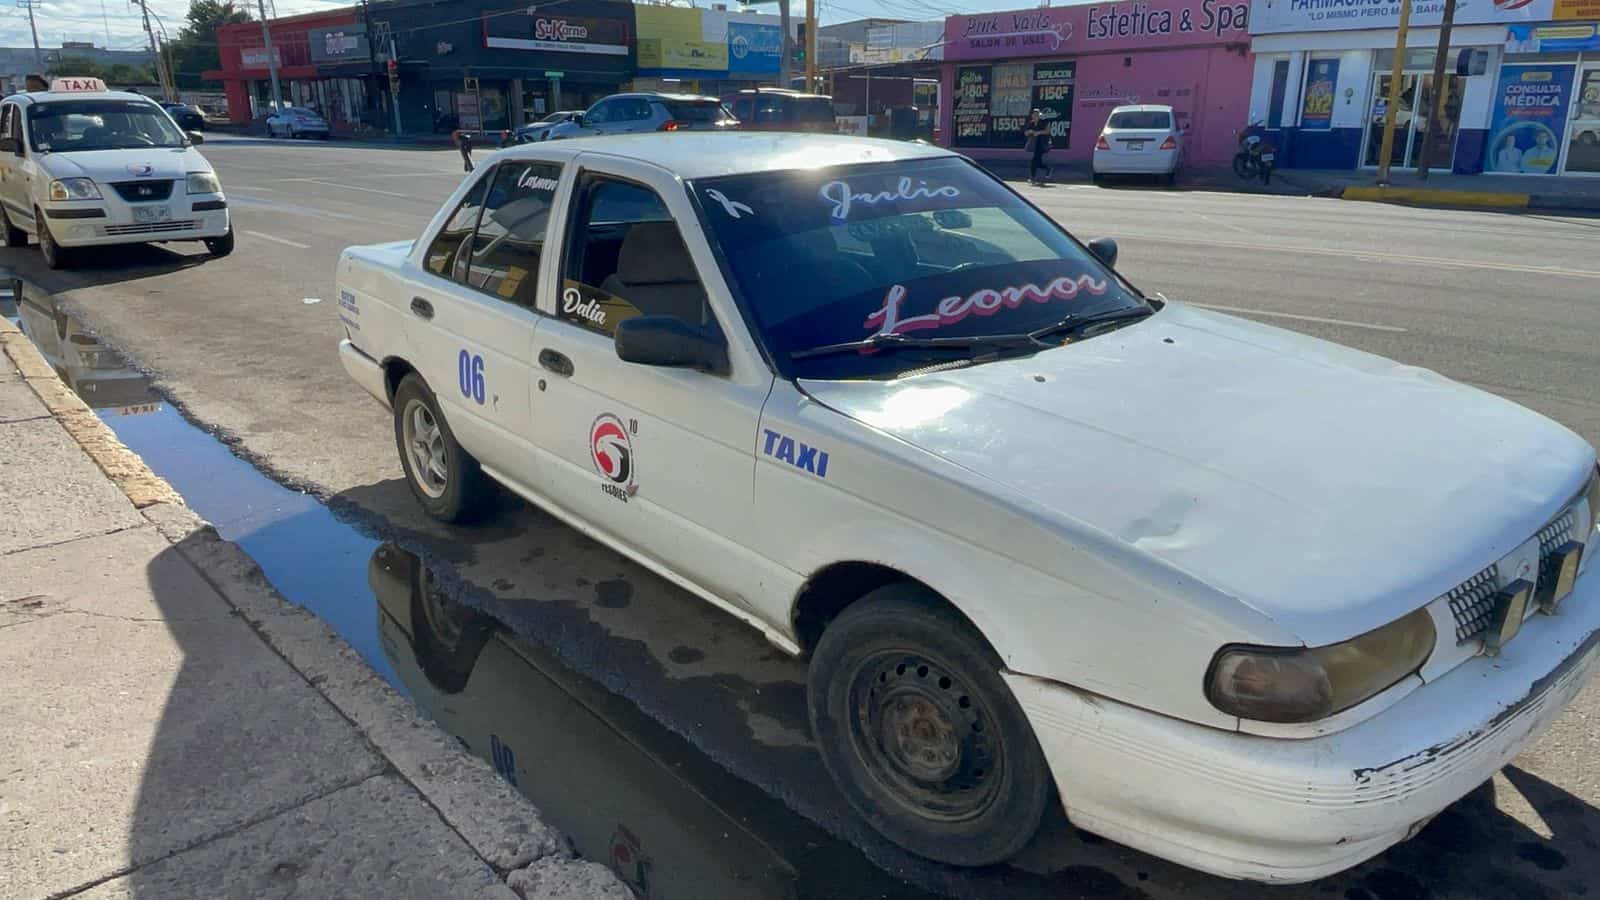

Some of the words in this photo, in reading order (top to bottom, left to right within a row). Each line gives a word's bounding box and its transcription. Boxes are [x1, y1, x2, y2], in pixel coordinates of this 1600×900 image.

[1087, 3, 1171, 39] Estetica
[1179, 8, 1192, 32] &
[1200, 0, 1248, 37] Spa
[1361, 7, 1388, 17] PERO
[60, 79, 98, 90] TAXI
[1506, 84, 1562, 94] CONSULTA
[820, 177, 961, 221] Julio
[563, 287, 607, 325] Dalia
[864, 274, 1108, 346] Leonor
[458, 349, 486, 406] 06
[628, 417, 639, 435] 10
[763, 428, 829, 479] TAXI
